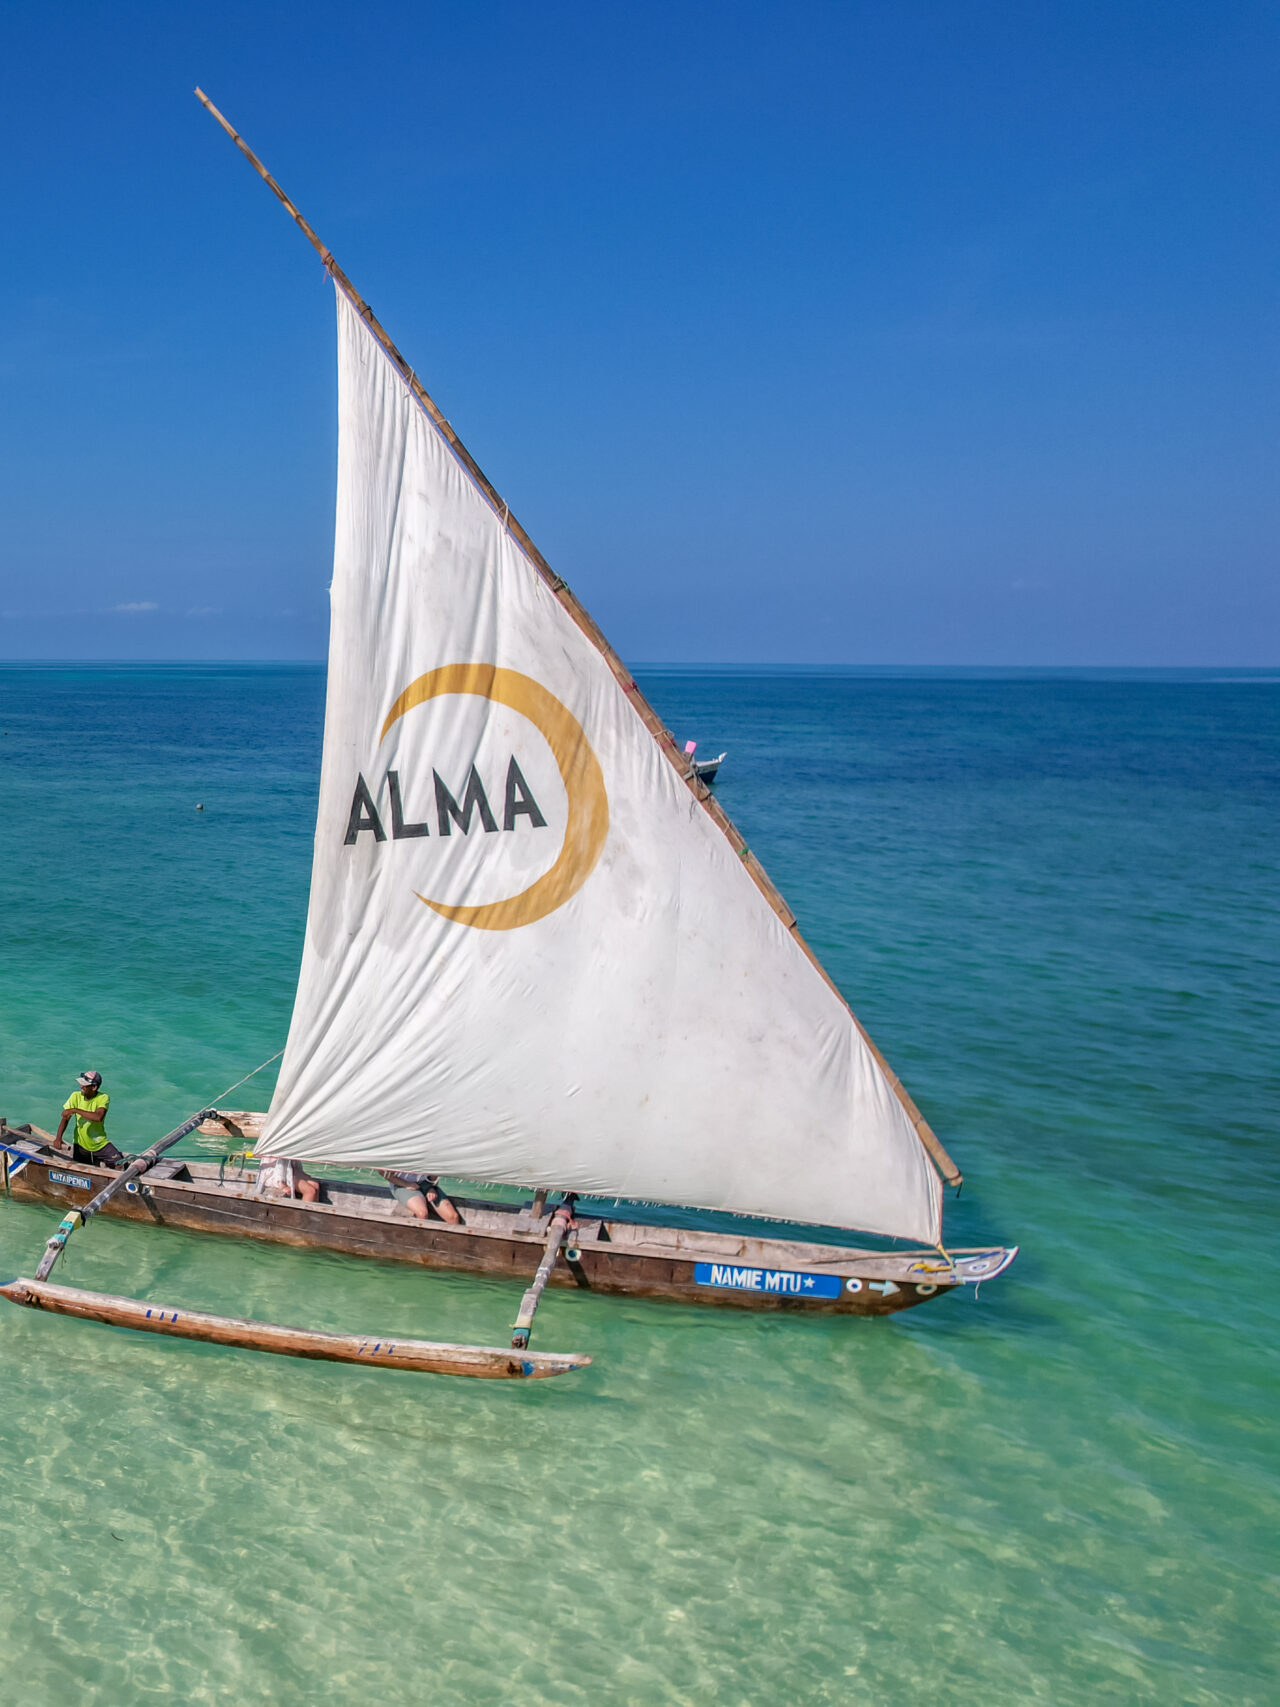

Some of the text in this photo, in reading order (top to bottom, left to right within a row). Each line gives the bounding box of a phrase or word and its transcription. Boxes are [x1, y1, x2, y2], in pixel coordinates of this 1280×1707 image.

[344, 754, 548, 845] ALMA
[711, 1264, 802, 1293] NAMIE MTU
